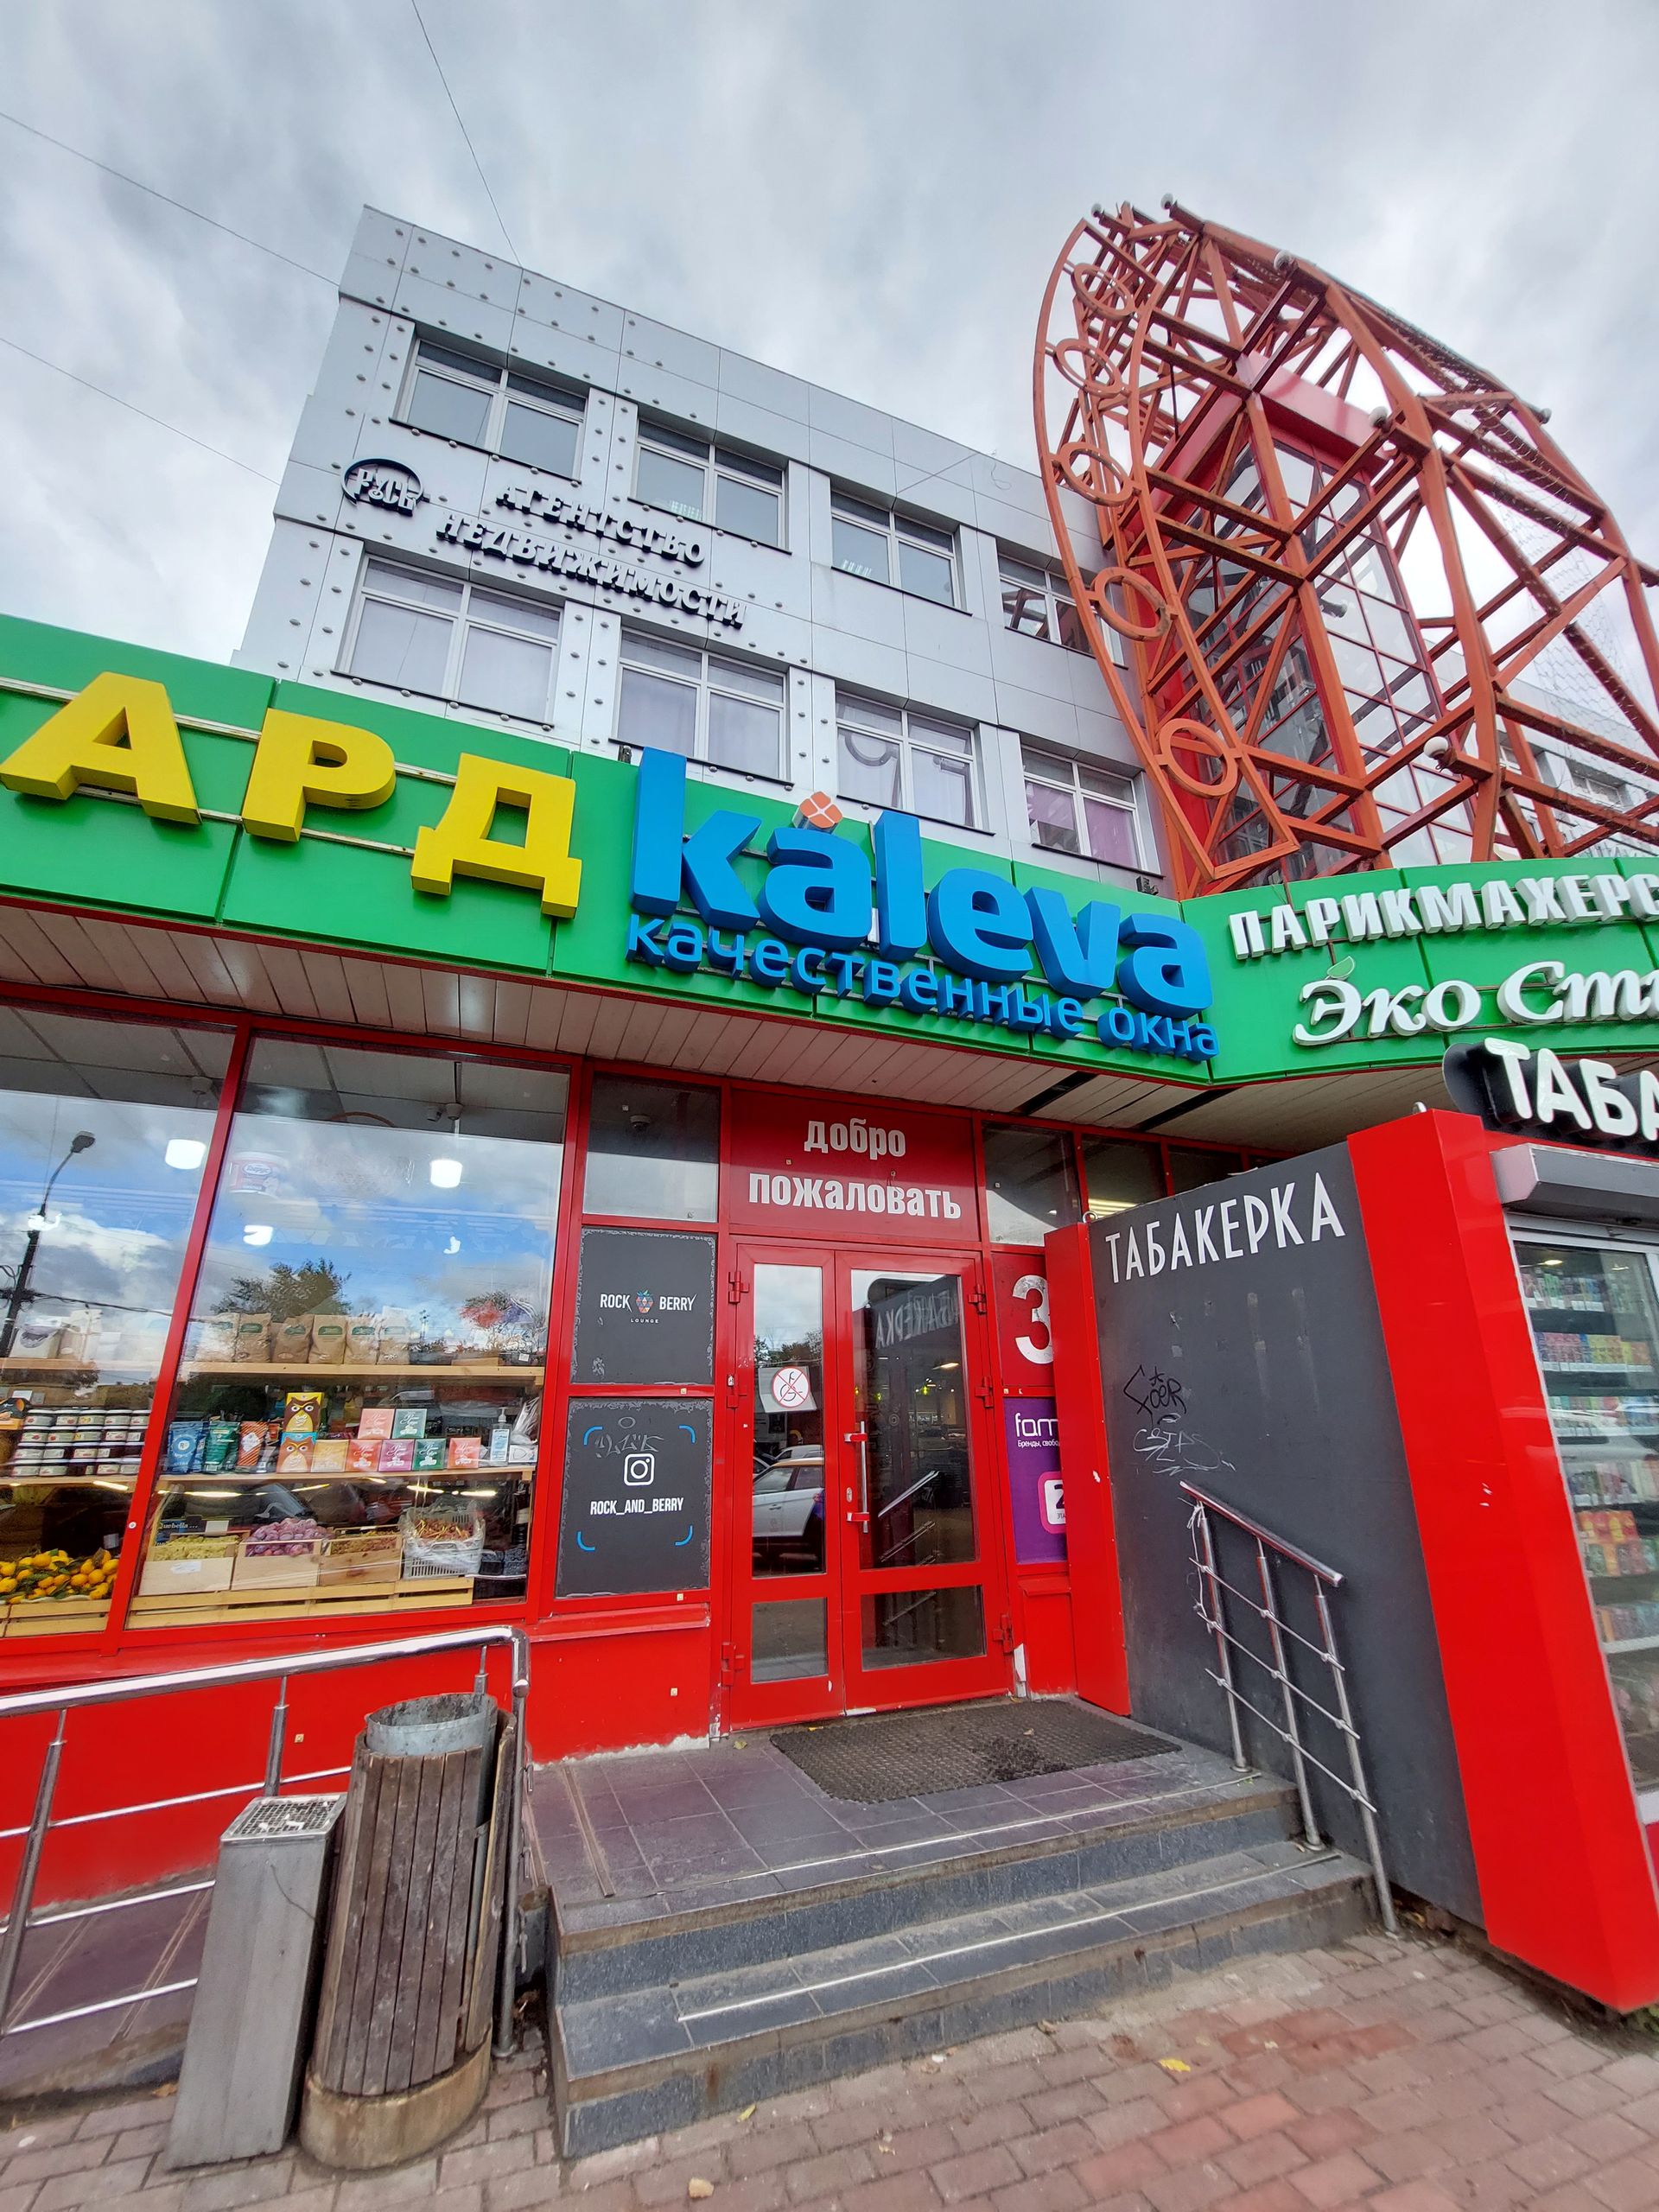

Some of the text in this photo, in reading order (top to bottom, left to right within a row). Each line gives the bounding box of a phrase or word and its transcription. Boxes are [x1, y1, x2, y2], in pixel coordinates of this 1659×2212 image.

[496, 484, 706, 568] АГЕНТСТВО
[435, 512, 747, 628] НЕДВИЖИМОСТИ
[0, 671, 582, 919] АРД
[631, 746, 1215, 1018] kaleva
[626, 913, 1220, 1064] качественные окна
[1292, 960, 1659, 1046] Эко Ст
[804, 1118, 906, 1160] добро
[748, 1172, 962, 1220] пожаловать
[1105, 1172, 1345, 1284] ТАБАКЕРКА
[600, 1294, 697, 1313] ROCK BERRY
[590, 1497, 684, 1515] ROCK_AND_BERRY
